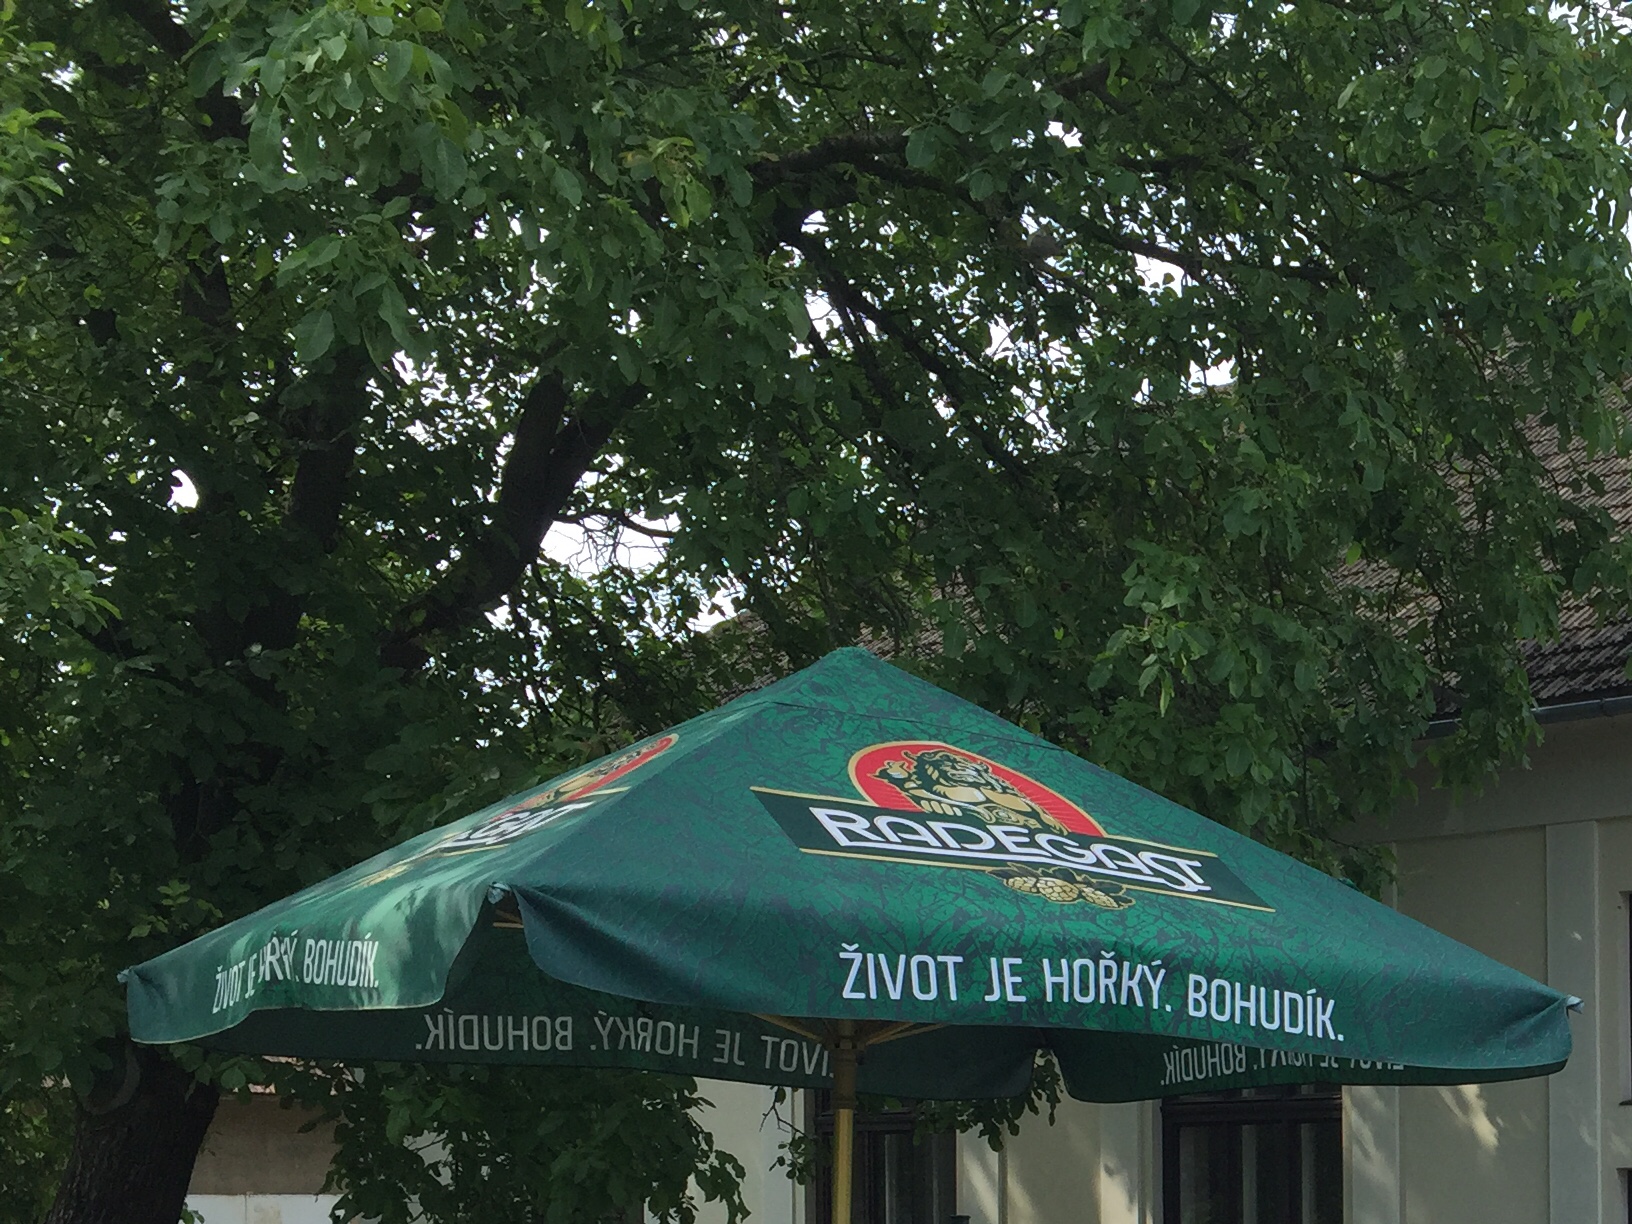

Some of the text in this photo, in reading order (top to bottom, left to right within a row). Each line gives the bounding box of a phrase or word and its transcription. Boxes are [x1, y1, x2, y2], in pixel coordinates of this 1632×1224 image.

[809, 806, 1212, 892] RADEGAST
[212, 960, 246, 1014] ŽIVOT
[303, 932, 379, 988] BOHUDÍK.
[839, 942, 1345, 1042] ŽIVOT JE HOŘKÝ. BOHUDÍK.
